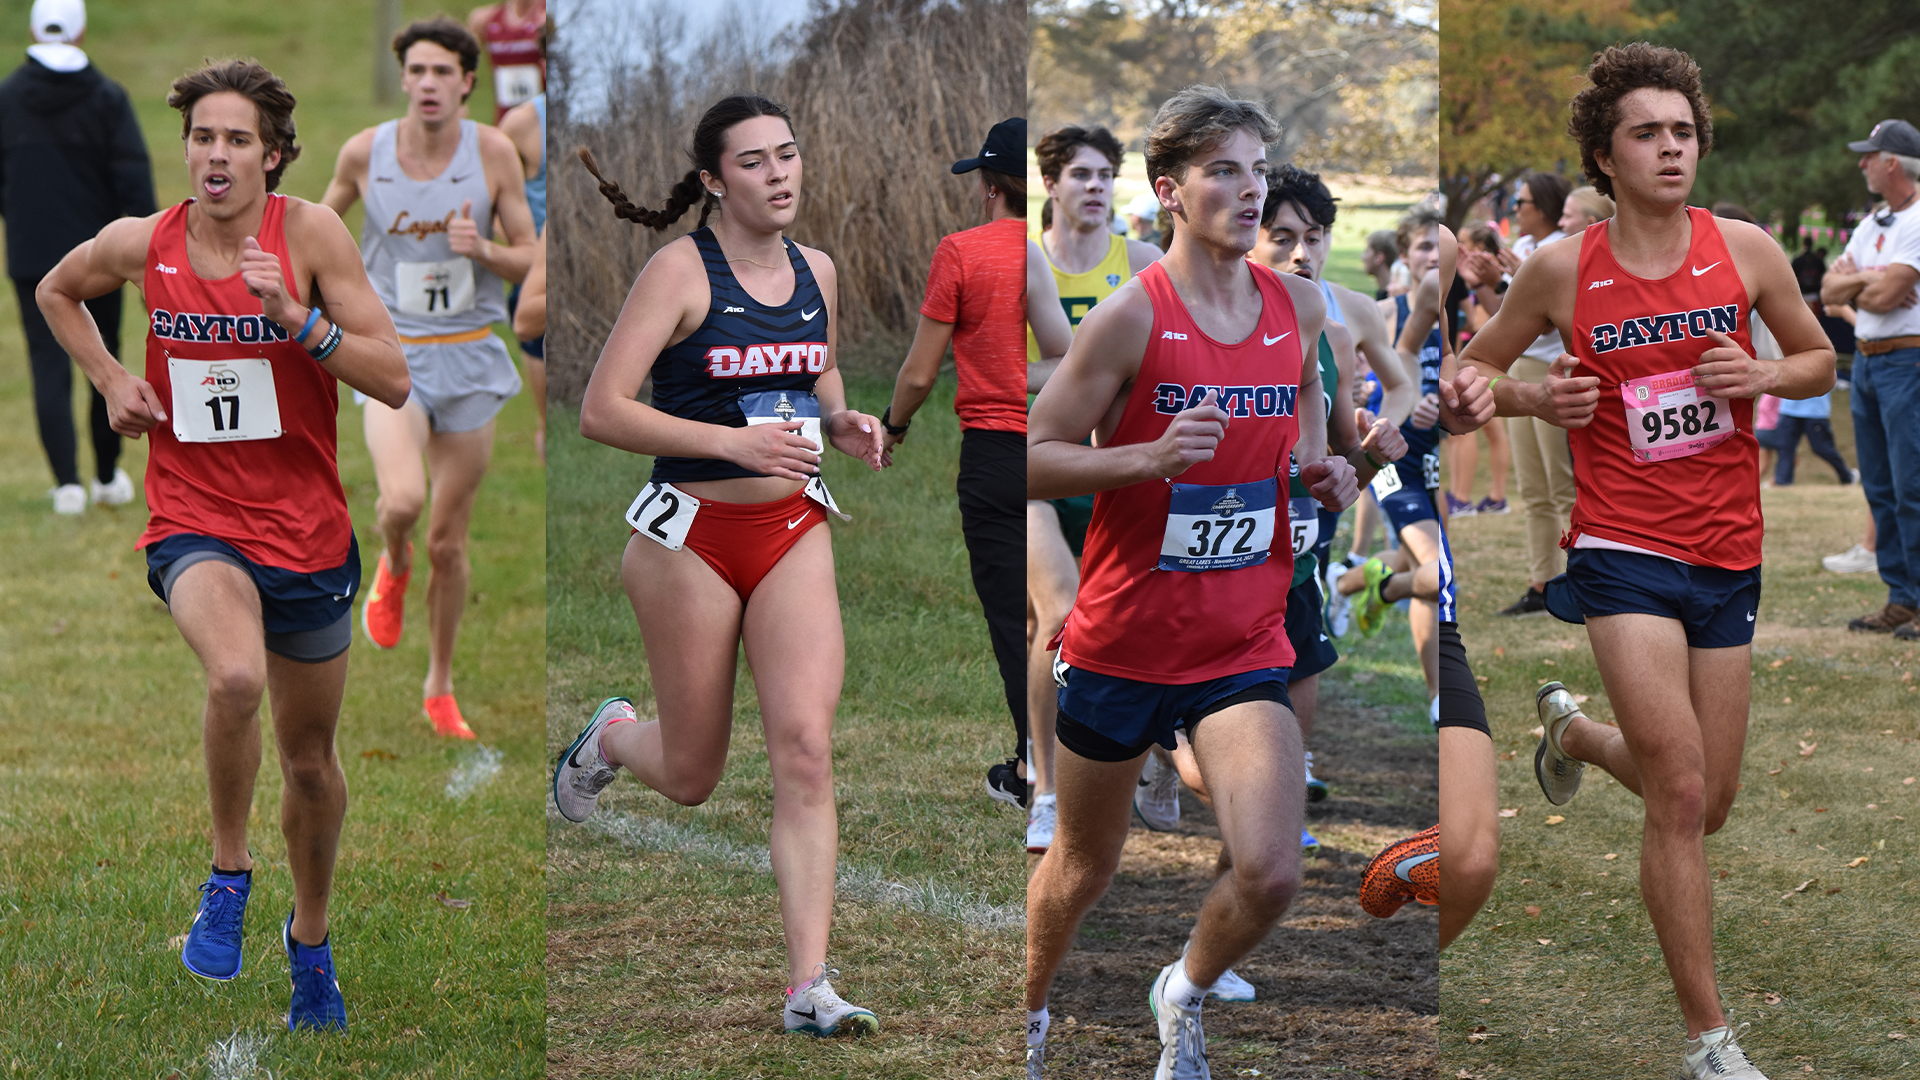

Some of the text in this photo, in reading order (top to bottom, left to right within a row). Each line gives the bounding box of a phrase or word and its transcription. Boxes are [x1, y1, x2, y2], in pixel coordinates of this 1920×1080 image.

[387, 209, 456, 241] Loyol
[155, 262, 178, 275] A10
[1588, 279, 1614, 290] A10
[425, 286, 450, 312] 71
[723, 305, 745, 313] A10
[151, 308, 289, 344] DAYTON
[1161, 330, 1188, 340] A10
[1590, 304, 1738, 354] DAYTON
[703, 341, 828, 379] DAYTO
[200, 376, 236, 386] A10
[204, 395, 240, 432] 17
[1151, 382, 1299, 418] DAYTON
[1642, 400, 1720, 444] 9582
[633, 482, 680, 540] 72
[1187, 517, 1257, 557] 372
